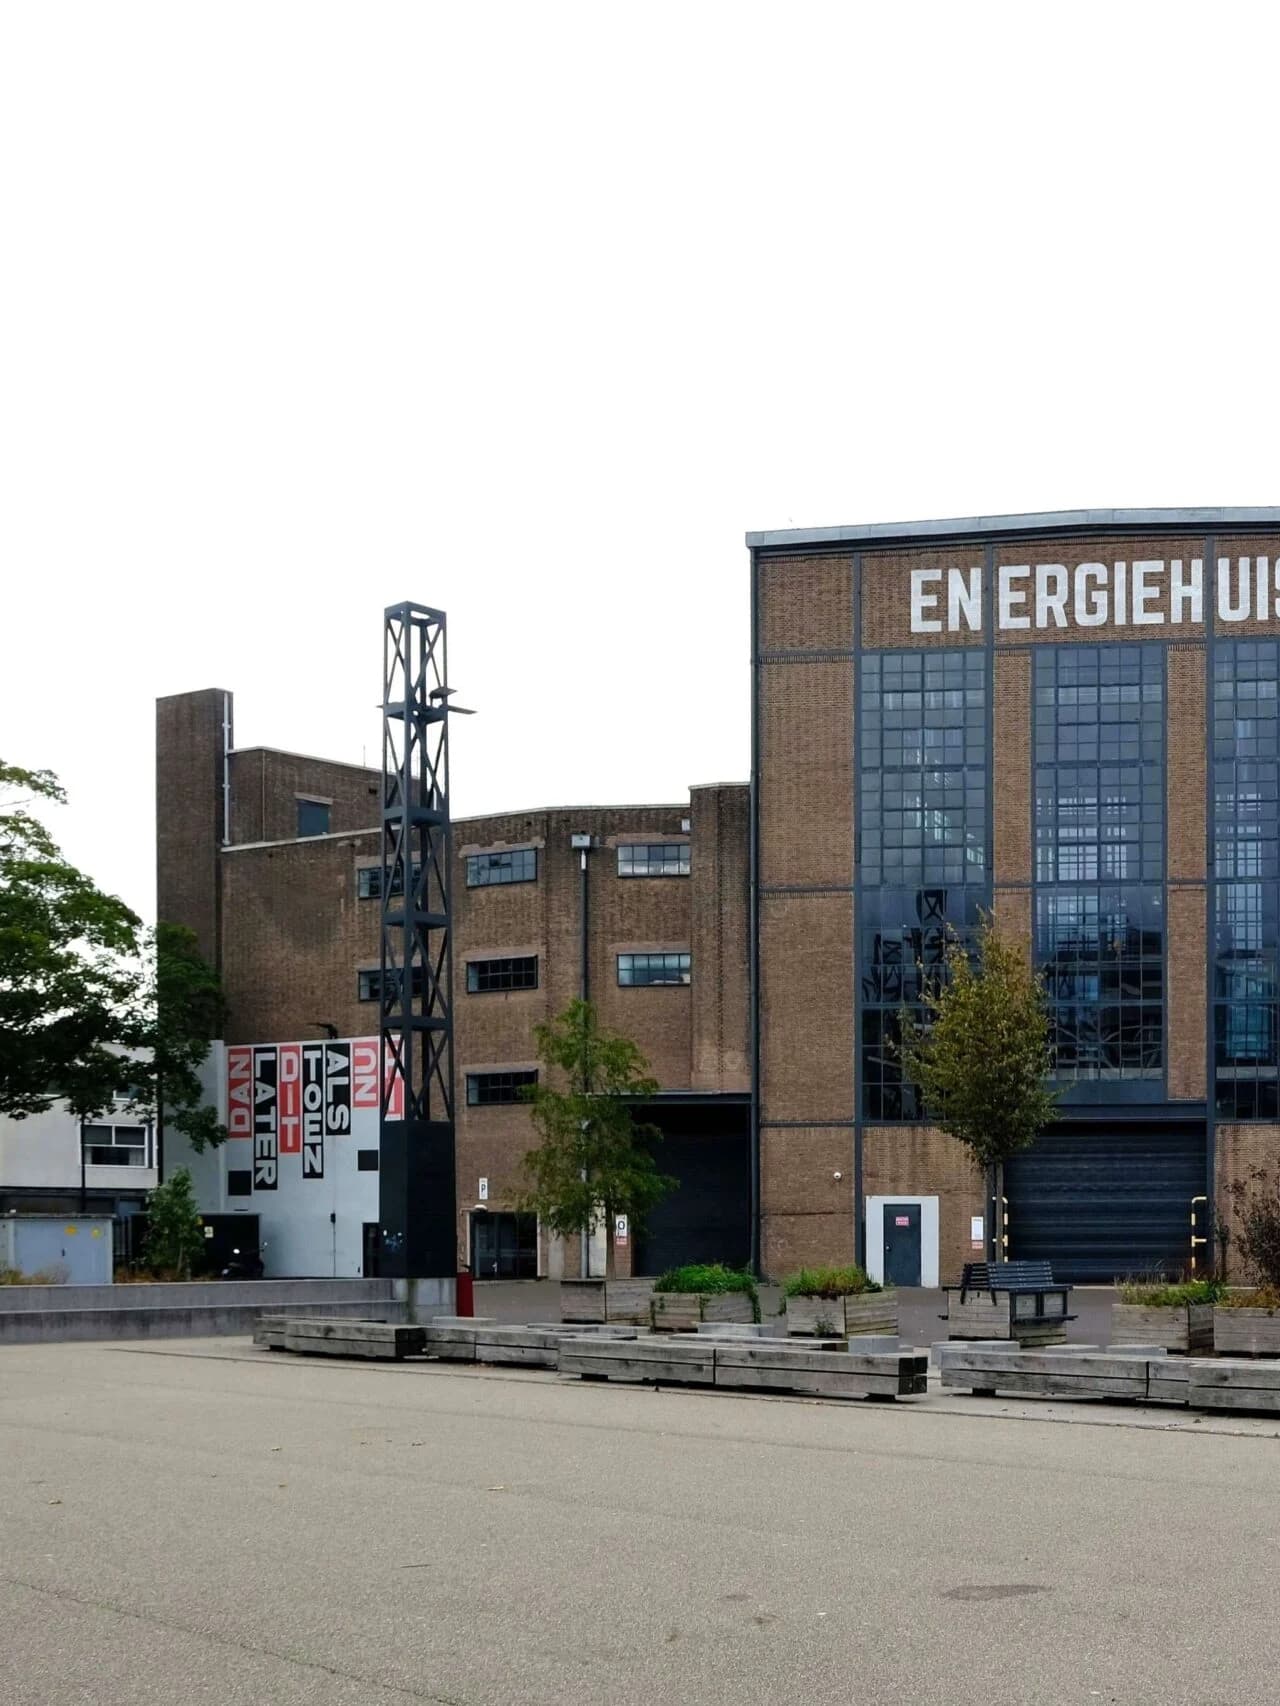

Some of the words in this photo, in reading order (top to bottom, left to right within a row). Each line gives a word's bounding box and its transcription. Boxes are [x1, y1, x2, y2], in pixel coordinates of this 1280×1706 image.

[255, 1053, 276, 1185] LATER
[282, 1052, 299, 1148] DIT
[304, 1051, 322, 1173] TOEN
[327, 1050, 349, 1130] ALS
